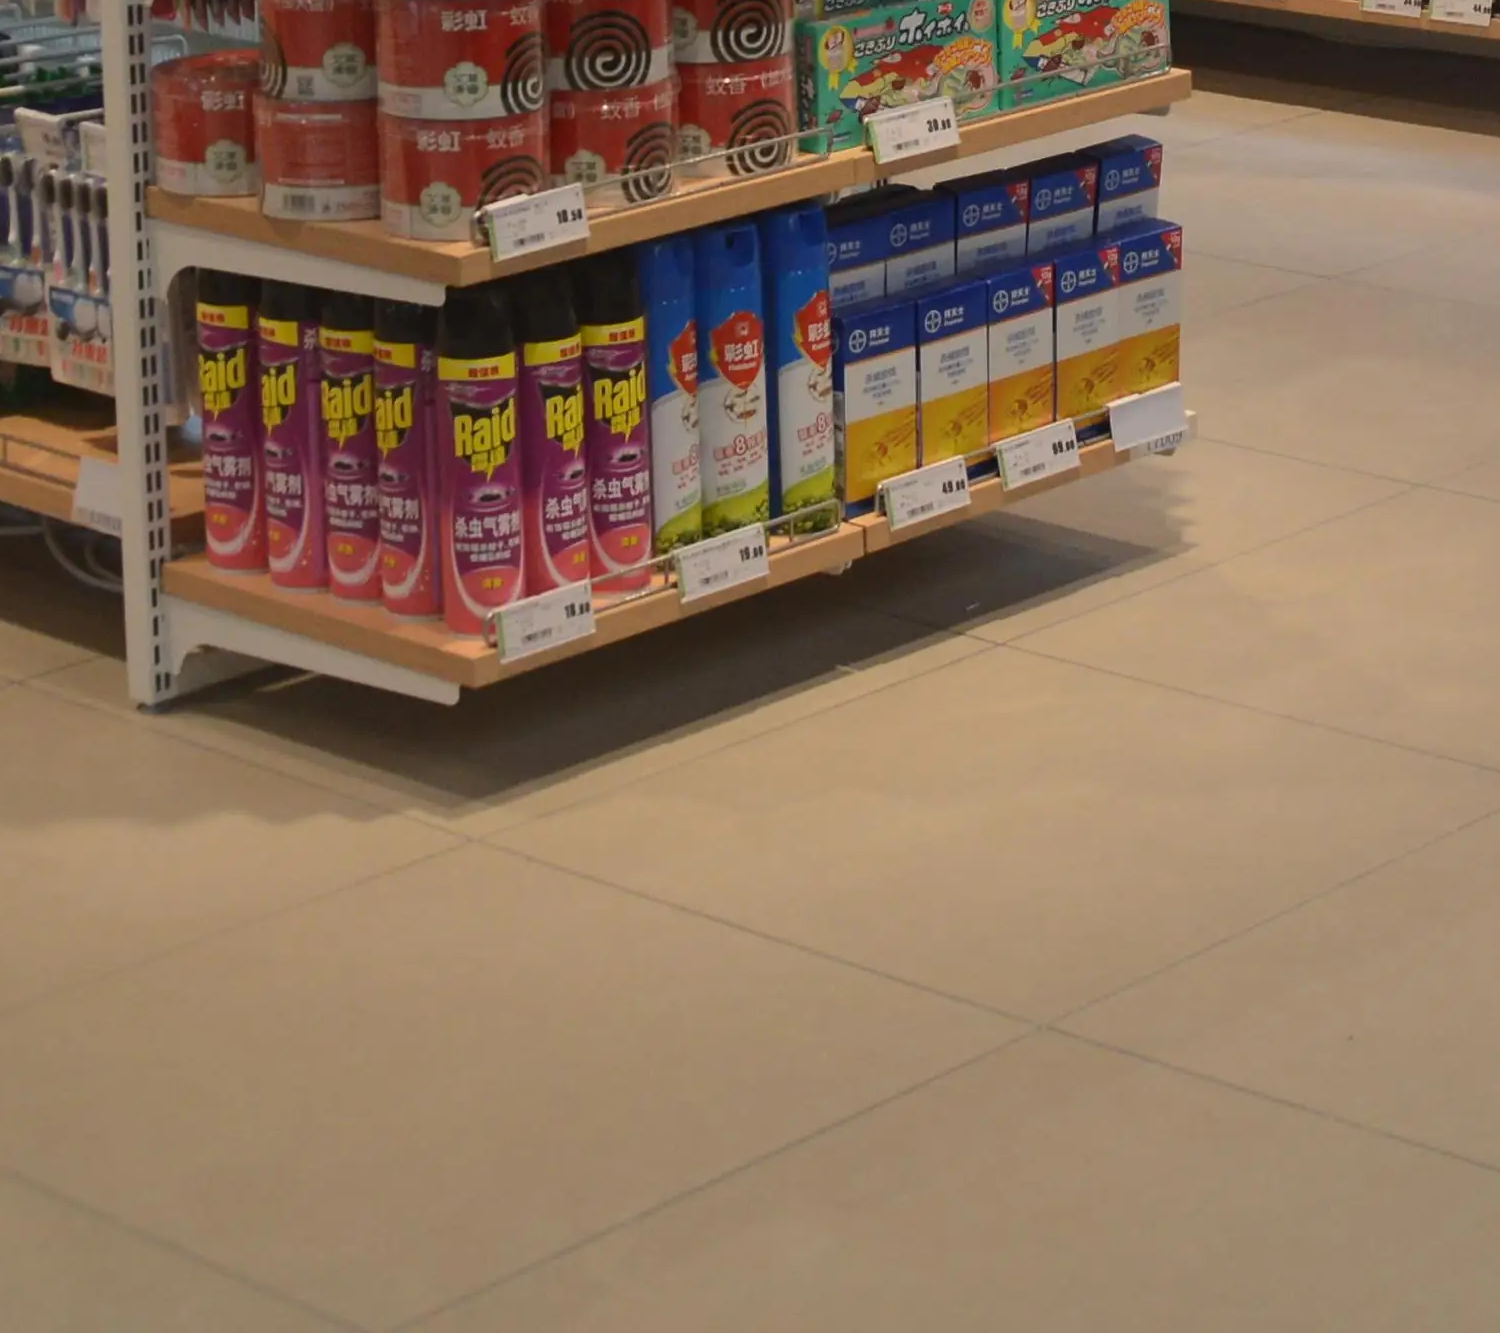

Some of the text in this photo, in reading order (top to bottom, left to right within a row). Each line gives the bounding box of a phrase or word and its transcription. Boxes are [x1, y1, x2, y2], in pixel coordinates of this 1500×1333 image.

[441, 8, 489, 32] 彩虹
[899, 8, 971, 46] ホイホイ
[705, 74, 745, 96] 蚊香
[201, 89, 245, 112] 彩虹
[601, 98, 641, 121] 蚊香
[417, 129, 462, 153] 彩虹
[486, 125, 525, 151] 蚊香
[594, 361, 646, 421] Raid
[454, 396, 516, 458] Raid
